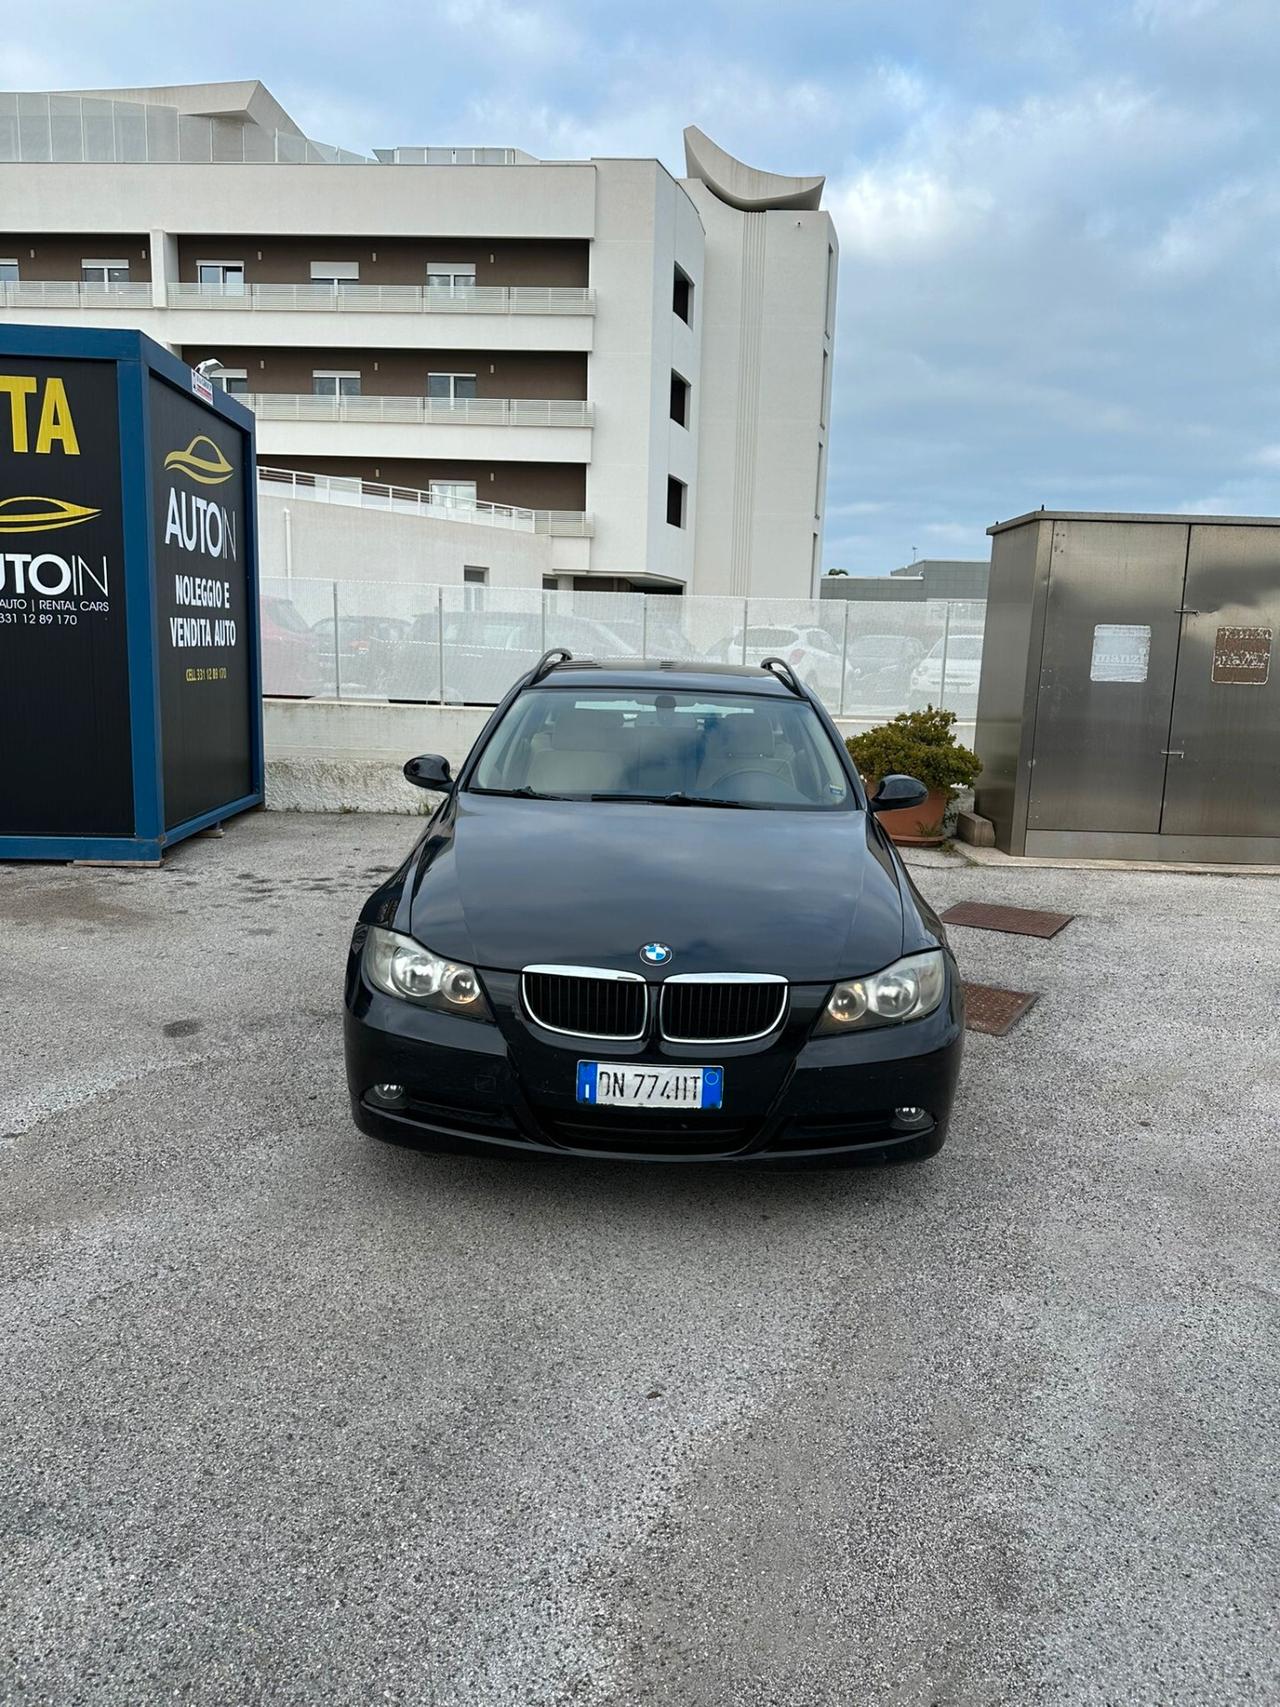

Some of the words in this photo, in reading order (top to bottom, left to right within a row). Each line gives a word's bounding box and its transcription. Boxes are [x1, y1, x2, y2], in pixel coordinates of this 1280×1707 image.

[165, 487, 236, 562] AUTOIN
[0, 553, 109, 597] TOIN
[0, 599, 27, 610] AUTO
[39, 600, 78, 611] RENTAL
[80, 601, 110, 612] CARS
[175, 574, 222, 608] NOLEGGIO
[224, 582, 230, 609] E
[23, 613, 36, 624] 12
[39, 614, 53, 625] 89
[57, 614, 78, 625] 170
[169, 617, 212, 647] VENDITA
[214, 619, 236, 647] AUTO
